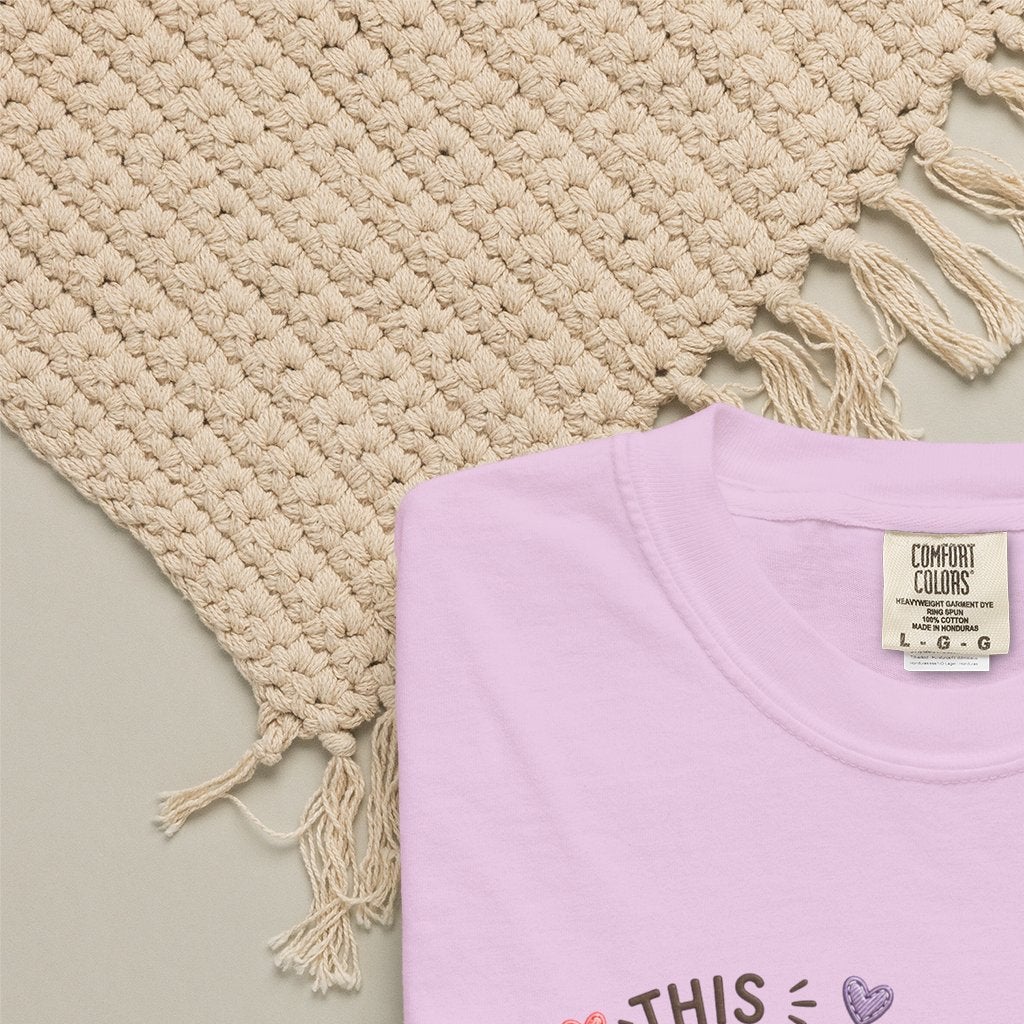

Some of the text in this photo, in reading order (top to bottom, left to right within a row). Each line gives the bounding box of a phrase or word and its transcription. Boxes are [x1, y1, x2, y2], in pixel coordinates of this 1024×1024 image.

[911, 543, 976, 568] COMFORT
[895, 598, 994, 609] HEAVYWEIGHT GARMENT DYE
[926, 608, 943, 616] RING
[922, 616, 940, 624] 100%
[912, 623, 932, 631] MADE
[941, 624, 979, 632] HONDURAS
[900, 632, 911, 647] L
[936, 635, 951, 650] G
[977, 635, 991, 651] G
